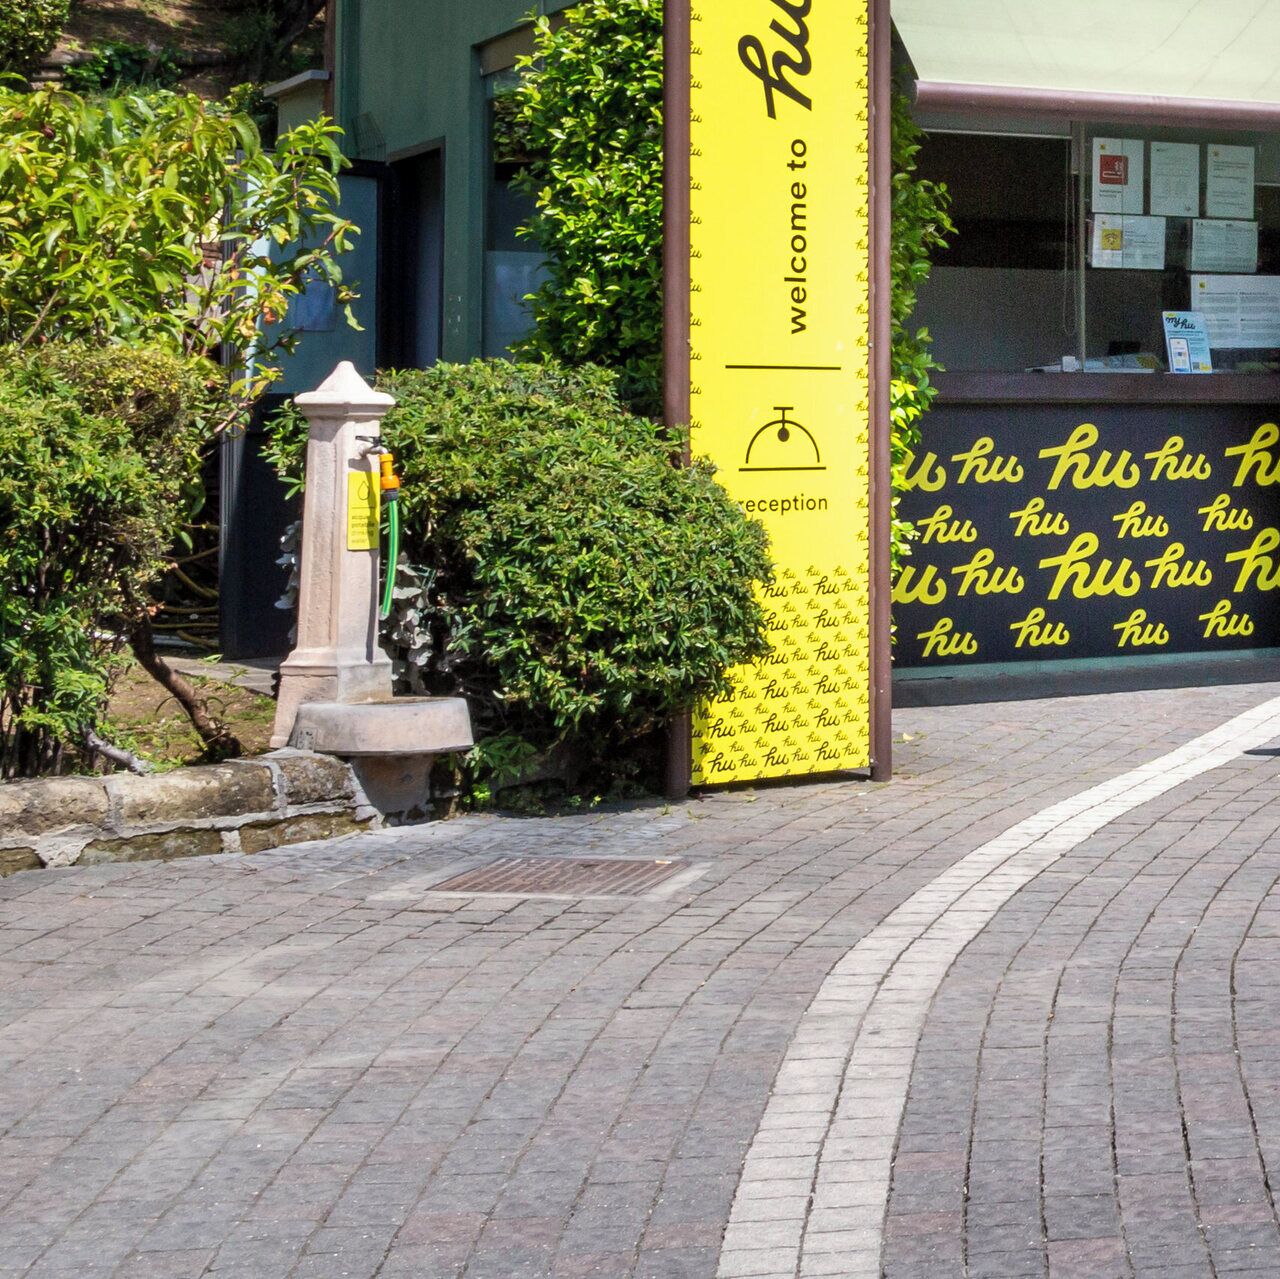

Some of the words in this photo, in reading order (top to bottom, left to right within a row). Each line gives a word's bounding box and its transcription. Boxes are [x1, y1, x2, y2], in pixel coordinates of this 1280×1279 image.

[787, 139, 807, 171] to
[784, 182, 807, 334] welcome
[898, 452, 947, 492] u
[951, 436, 1024, 484] hu
[1038, 423, 1140, 490] hu
[1144, 436, 1212, 481] hu
[917, 505, 977, 544] hu
[1009, 497, 1070, 537] hu
[1112, 500, 1169, 538] hu
[1197, 493, 1253, 532] hu
[782, 568, 795, 579] hu
[806, 565, 820, 576] hu
[833, 566, 846, 576] hu
[891, 565, 947, 605] u
[951, 548, 1024, 596] hu
[1038, 532, 1140, 601] hu
[1144, 542, 1213, 589] hu
[791, 581, 808, 594] hu
[814, 576, 839, 595] hu
[842, 578, 858, 591] hu
[782, 602, 796, 612] hu
[806, 599, 820, 609] hu
[833, 599, 846, 609] hu
[791, 614, 808, 627] hu
[814, 609, 839, 628] hu
[842, 611, 858, 624] hu
[917, 617, 978, 656] hu
[1009, 607, 1070, 648] hu
[1112, 608, 1169, 647] hu
[1198, 599, 1254, 637] hu
[782, 635, 796, 646] hu
[806, 632, 820, 642] hu
[833, 632, 846, 642] hu
[791, 648, 808, 661] hu
[814, 642, 840, 662] hu
[842, 644, 859, 657] hu
[754, 670, 769, 681] hu
[782, 669, 796, 679] hu
[807, 665, 820, 676] hu
[833, 665, 846, 675] hu
[738, 686, 756, 699] hu
[762, 679, 789, 699] hu
[791, 681, 809, 694] hu
[814, 675, 840, 695] hu
[842, 677, 859, 689] hu
[729, 707, 744, 718] hu
[754, 703, 769, 714] hu
[782, 702, 796, 713] hu
[807, 698, 821, 709] hu
[834, 697, 847, 707] hu
[707, 718, 736, 739] hu
[738, 720, 757, 734] hu
[762, 713, 789, 733] hu
[791, 714, 809, 728] hu
[814, 708, 840, 728] hu
[843, 710, 859, 722] hu
[729, 741, 744, 752] hu
[754, 737, 769, 748] hu
[783, 736, 797, 746] hu
[807, 732, 821, 742] hu
[834, 730, 847, 741] hu
[708, 752, 736, 773] hu
[738, 753, 757, 767] hu
[762, 746, 789, 767] hu
[791, 748, 809, 761] hu
[814, 741, 840, 761] hu
[843, 742, 860, 756] hu
